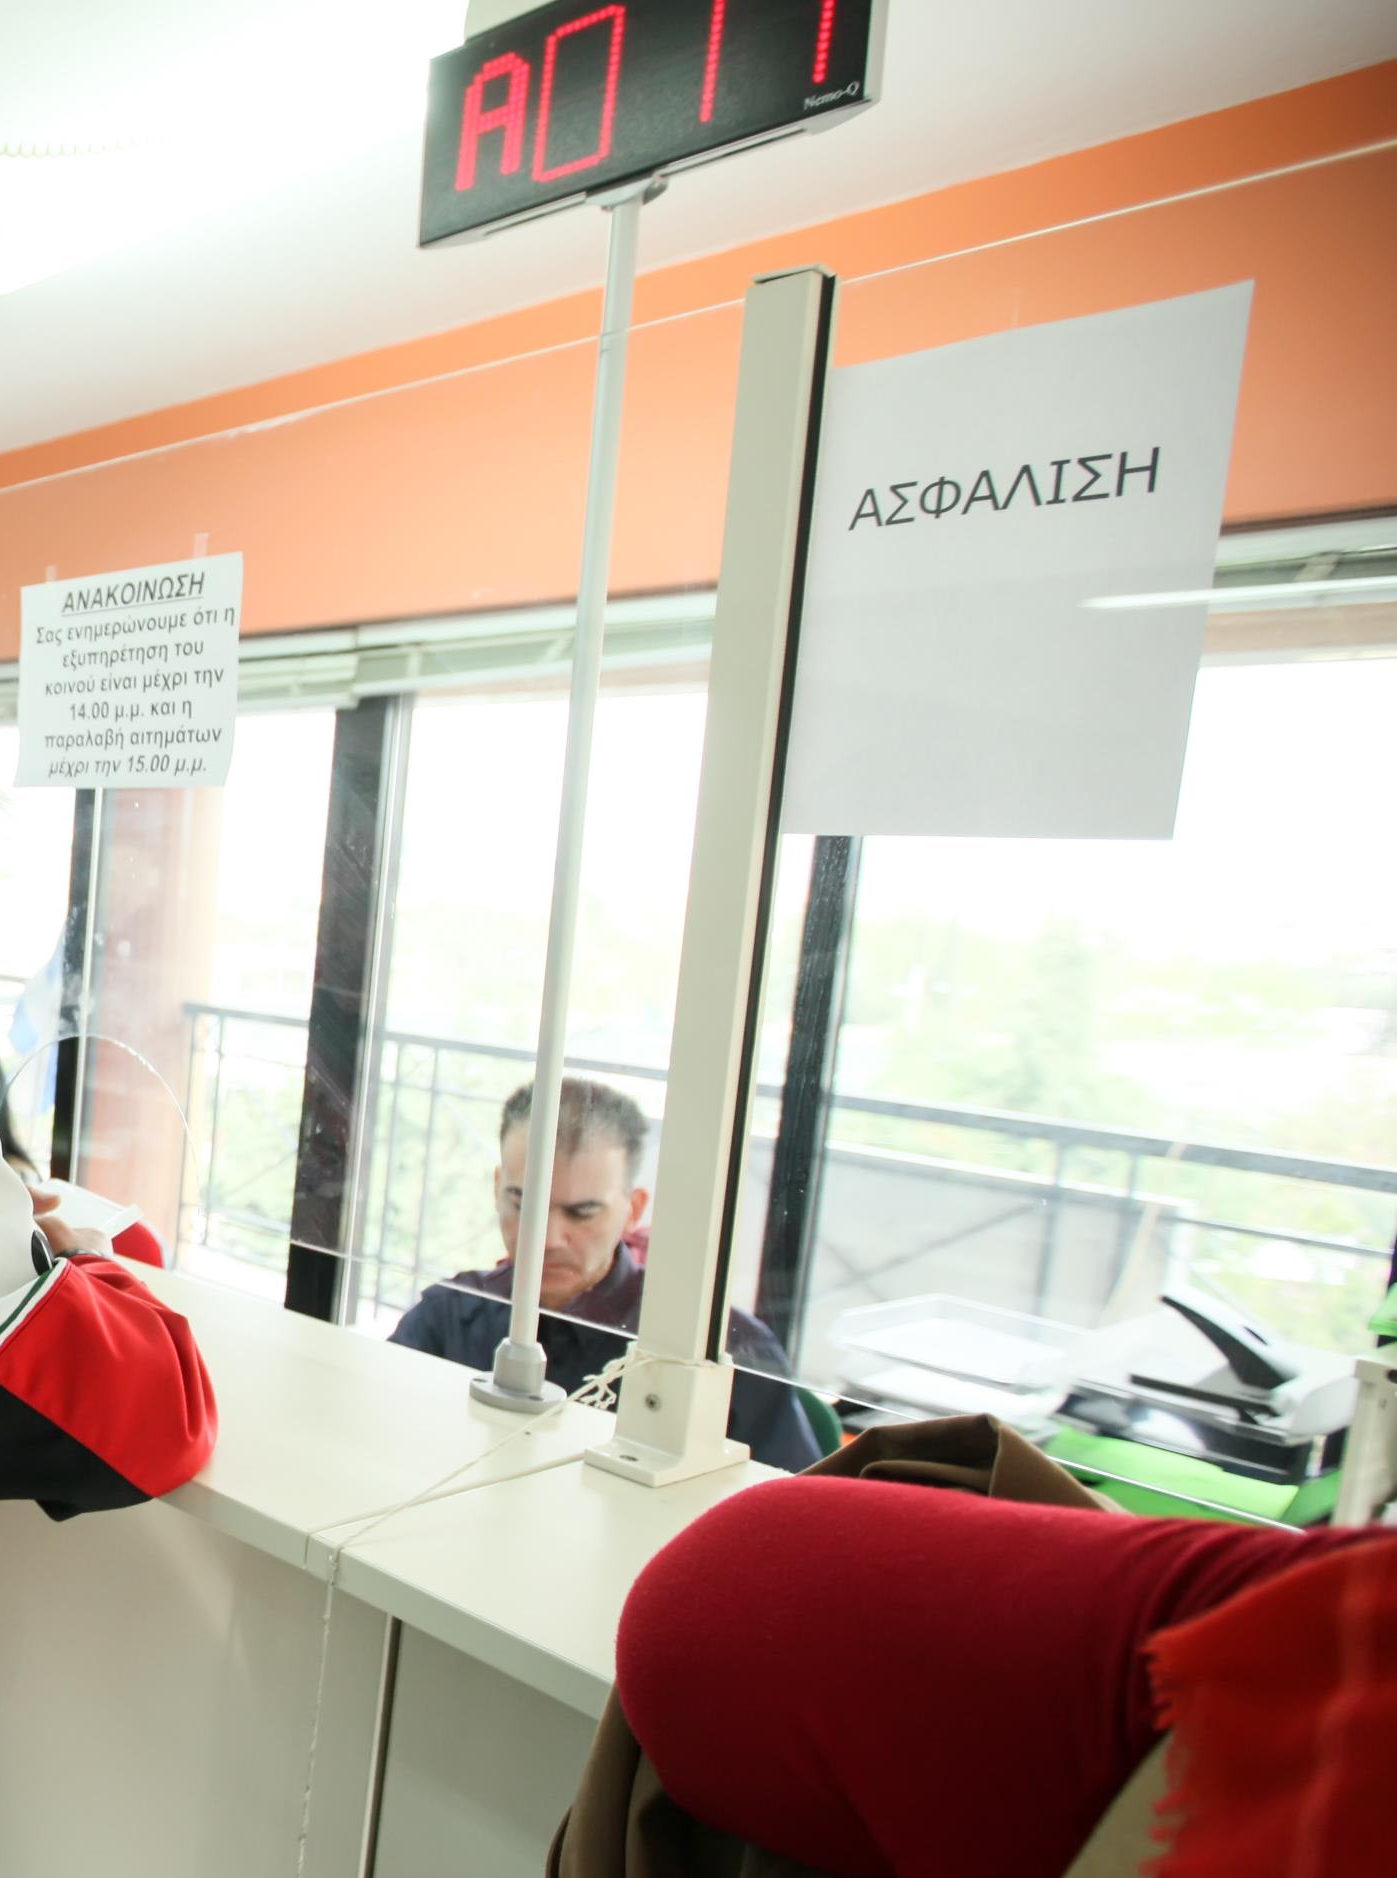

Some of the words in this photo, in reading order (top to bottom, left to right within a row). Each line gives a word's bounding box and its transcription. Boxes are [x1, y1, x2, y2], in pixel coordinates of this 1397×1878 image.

[848, 446, 1161, 531] ΑΣΦΑΛΙΣΗ
[61, 571, 205, 614] ΑΝΑΚΟΙΝΩΣΗ
[36, 626, 63, 646] Σας
[66, 612, 188, 642] ενημερώνουμε
[193, 606, 218, 626] ότι
[224, 606, 236, 627] η
[62, 642, 168, 672] εξυπηρέτηση
[175, 640, 205, 656] του
[45, 674, 95, 696] κοινού
[100, 672, 137, 692] είναι
[142, 669, 188, 692] μέχρι
[194, 668, 224, 688] την
[70, 702, 110, 721] 14.00
[115, 704, 145, 722] μ.μ.
[151, 701, 176, 716] και
[182, 699, 193, 719] η
[45, 727, 124, 751] παραλαβή
[130, 724, 223, 749] αιτημάτων
[48, 756, 90, 778] μέχρι
[95, 759, 121, 777] την
[127, 753, 171, 774] 15.00
[174, 758, 207, 777] μ.μ.
